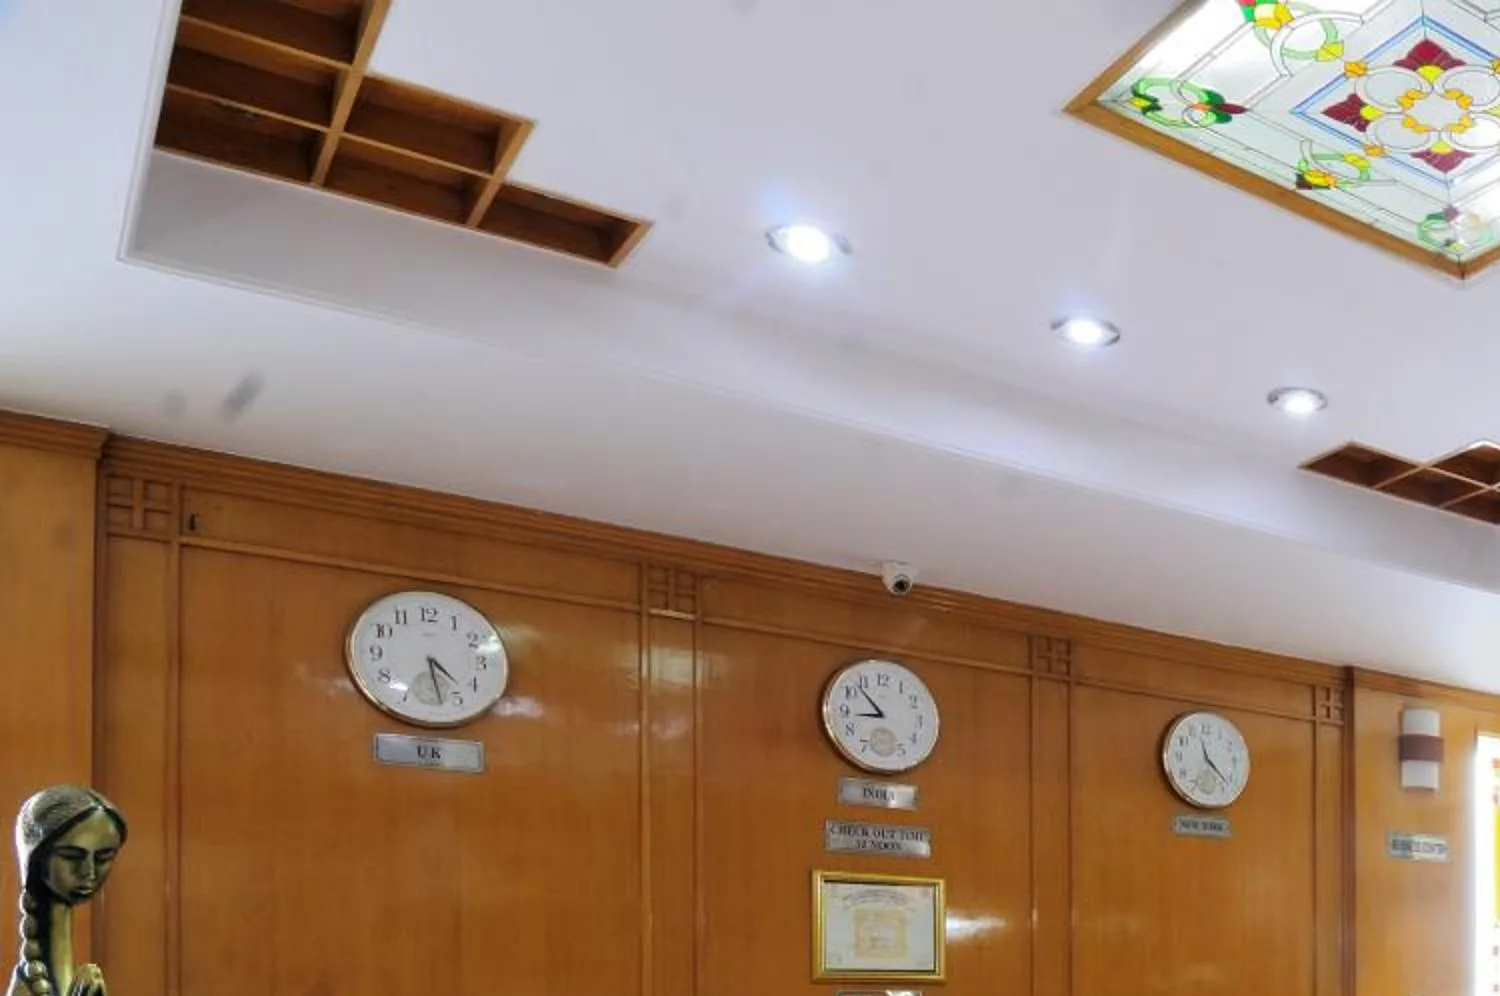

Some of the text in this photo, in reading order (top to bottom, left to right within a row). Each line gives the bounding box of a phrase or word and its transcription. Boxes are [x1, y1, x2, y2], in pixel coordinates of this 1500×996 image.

[395, 606, 407, 625] 11
[420, 608, 438, 622] 12
[376, 623, 393, 638] 10
[452, 615, 459, 631] 1
[467, 632, 479, 648] 2
[370, 645, 382, 661] 9
[476, 655, 487, 670] 3
[378, 668, 391, 684] 8
[877, 672, 890, 687] 12
[467, 677, 478, 693] 4
[844, 685, 857, 699] 10
[452, 691, 464, 707] 5
[910, 695, 918, 709] 2
[839, 704, 850, 717] 9
[845, 722, 855, 736] 8
[862, 786, 896, 801] INDIA
[829, 822, 869, 837] CHECK
[873, 826, 897, 839] OUT
